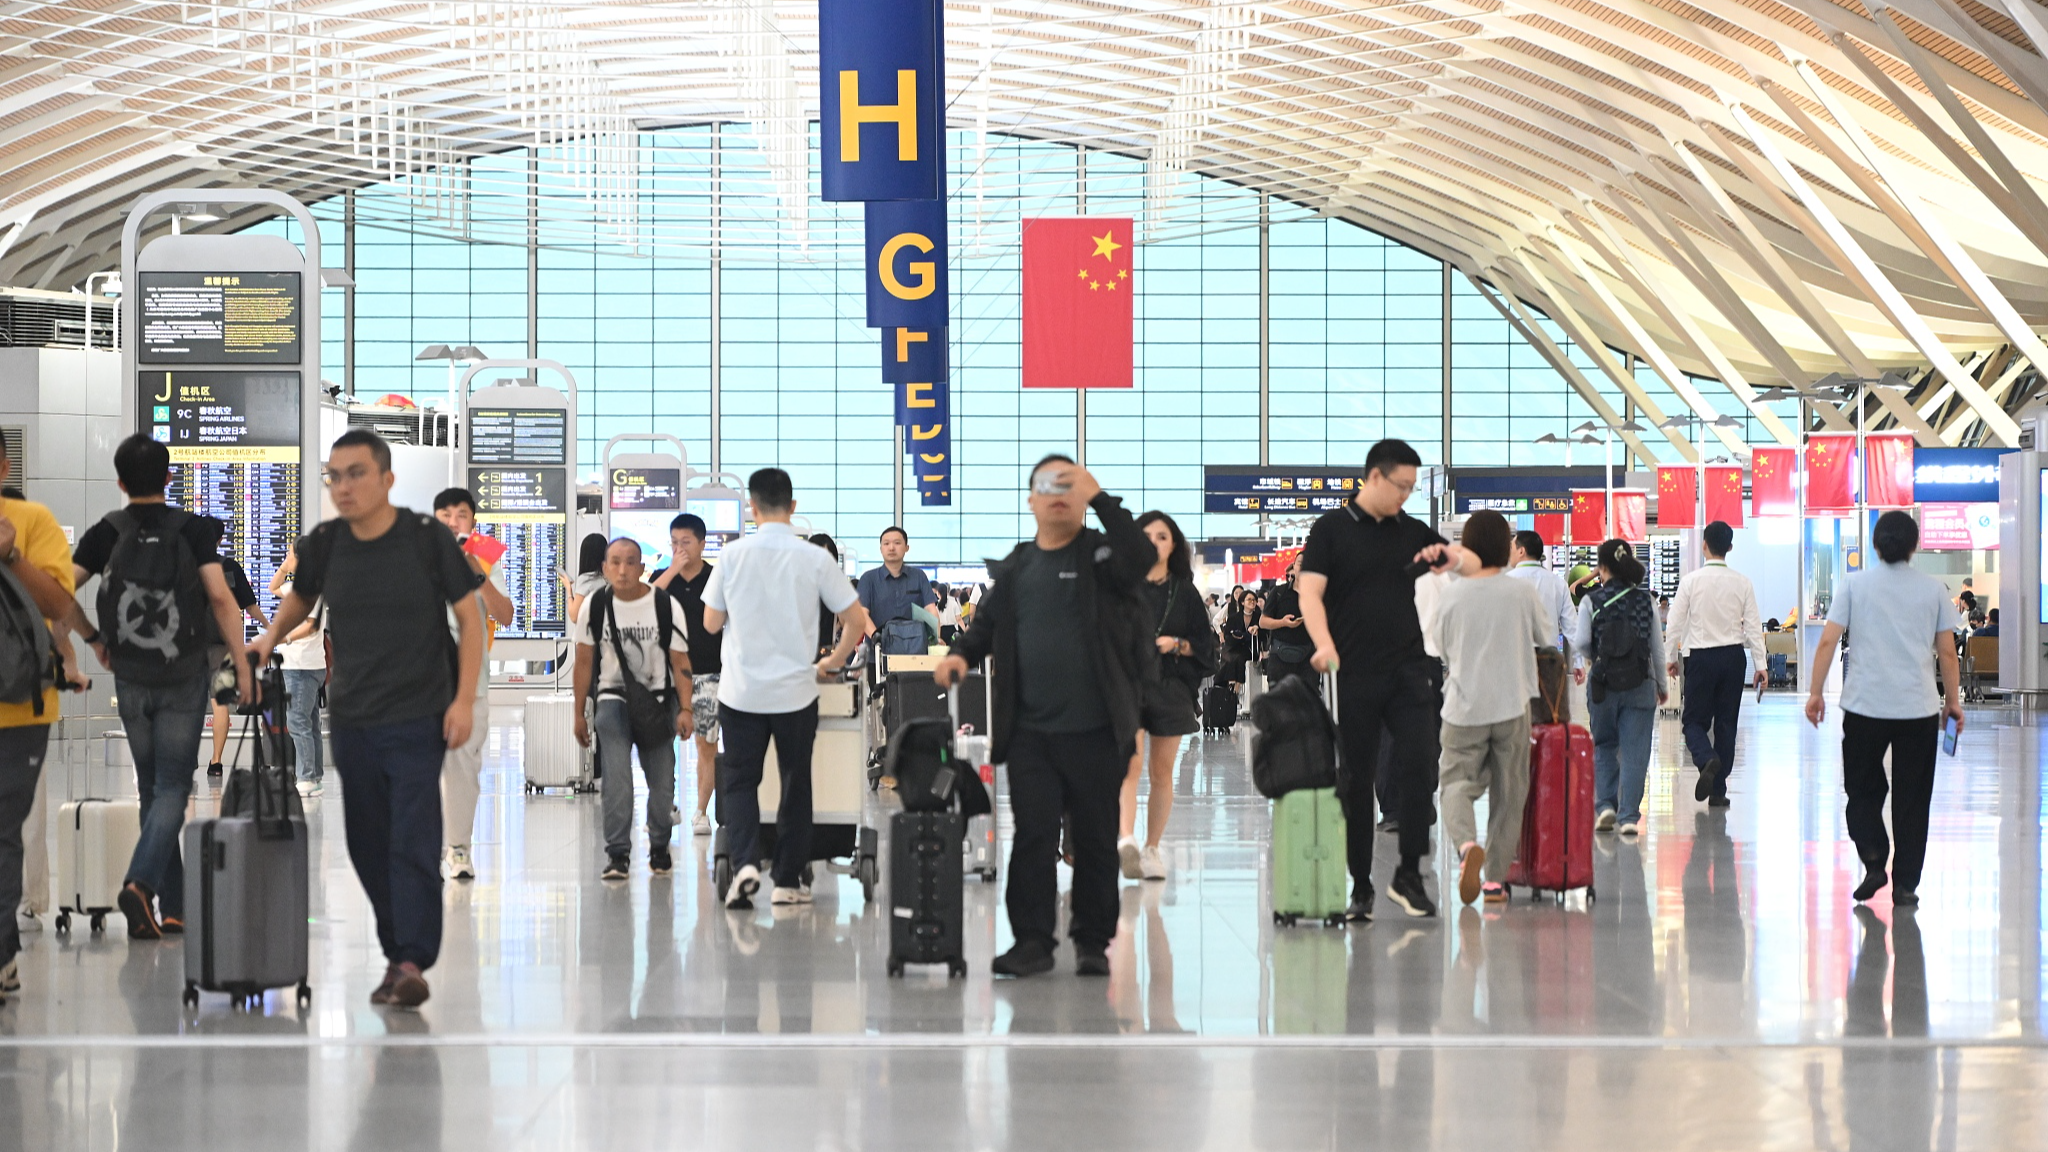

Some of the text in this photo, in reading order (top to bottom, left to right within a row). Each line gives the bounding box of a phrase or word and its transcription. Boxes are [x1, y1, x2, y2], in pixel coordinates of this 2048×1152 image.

[840, 70, 917, 161] H
[878, 232, 935, 300] G
[155, 372, 172, 402] J
[180, 386, 210, 396] 值机区
[177, 406, 232, 419] 9C 春秋航空
[199, 426, 247, 436] 春秋航空日本
[536, 472, 542, 483] 1
[613, 469, 628, 486] G
[535, 485, 542, 496] 2
